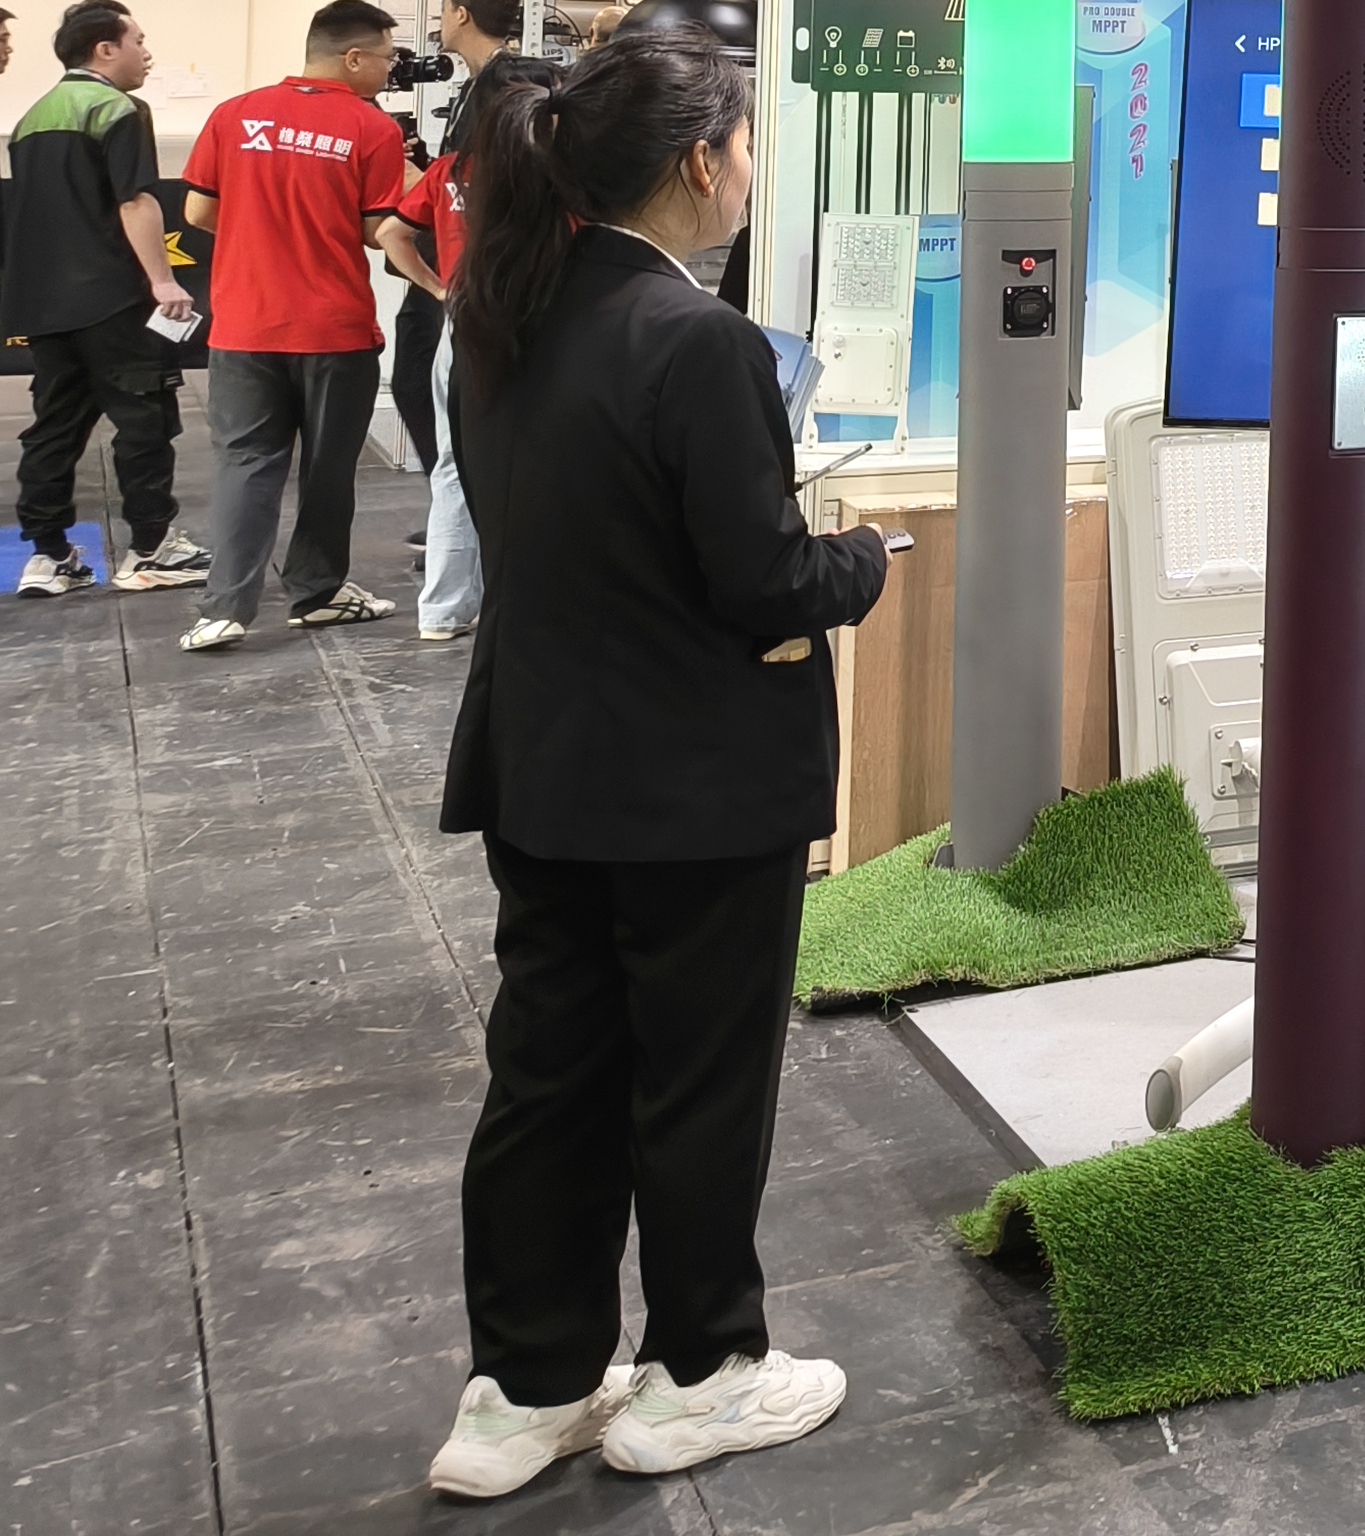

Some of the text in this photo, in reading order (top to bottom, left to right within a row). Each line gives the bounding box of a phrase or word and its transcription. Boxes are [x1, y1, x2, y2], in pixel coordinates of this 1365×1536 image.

[1083, 6, 1135, 17] PRO DOUBLE
[1092, 20, 1127, 33] MPPT
[919, 237, 956, 252] MPPT
